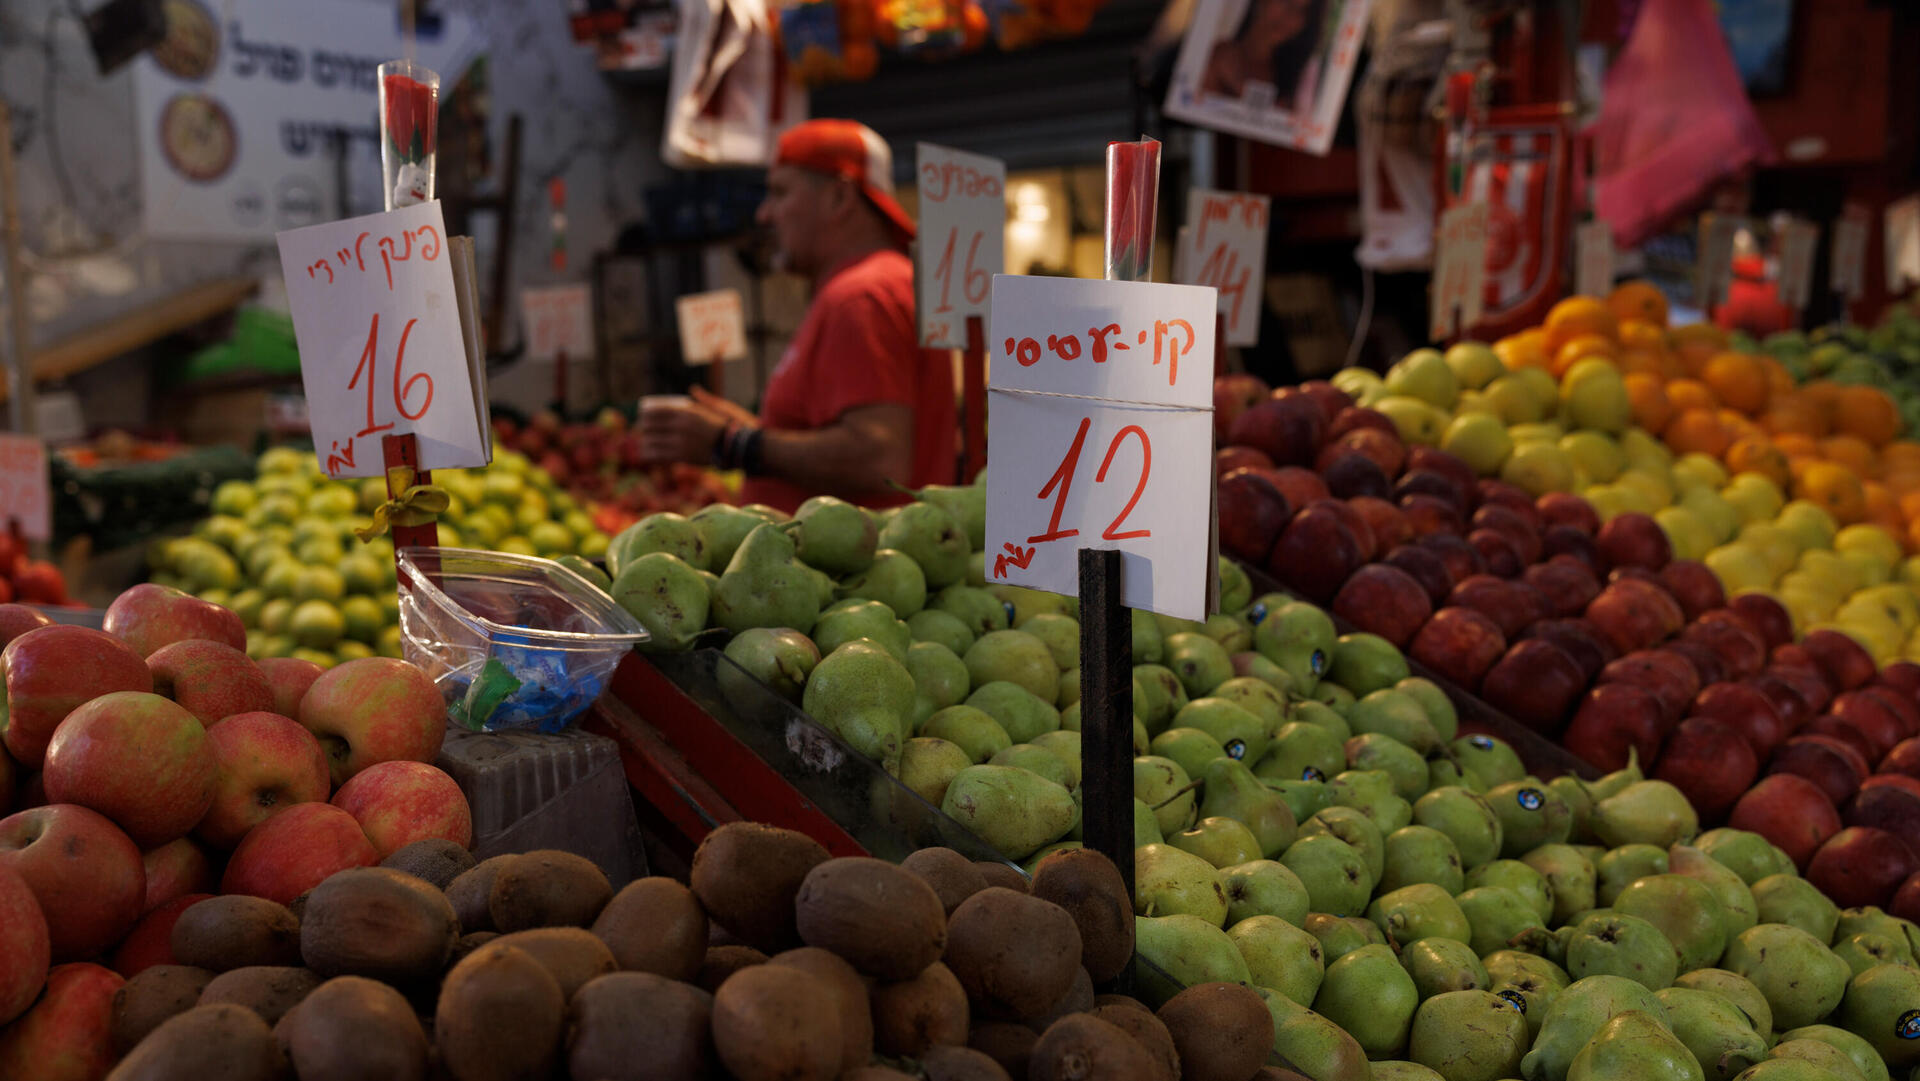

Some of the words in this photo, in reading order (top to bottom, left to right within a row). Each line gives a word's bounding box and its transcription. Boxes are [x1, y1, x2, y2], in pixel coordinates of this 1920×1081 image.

[934, 225, 992, 314] 16
[1196, 241, 1252, 332] 14
[347, 313, 434, 438] 16
[1027, 416, 1152, 545] 12
